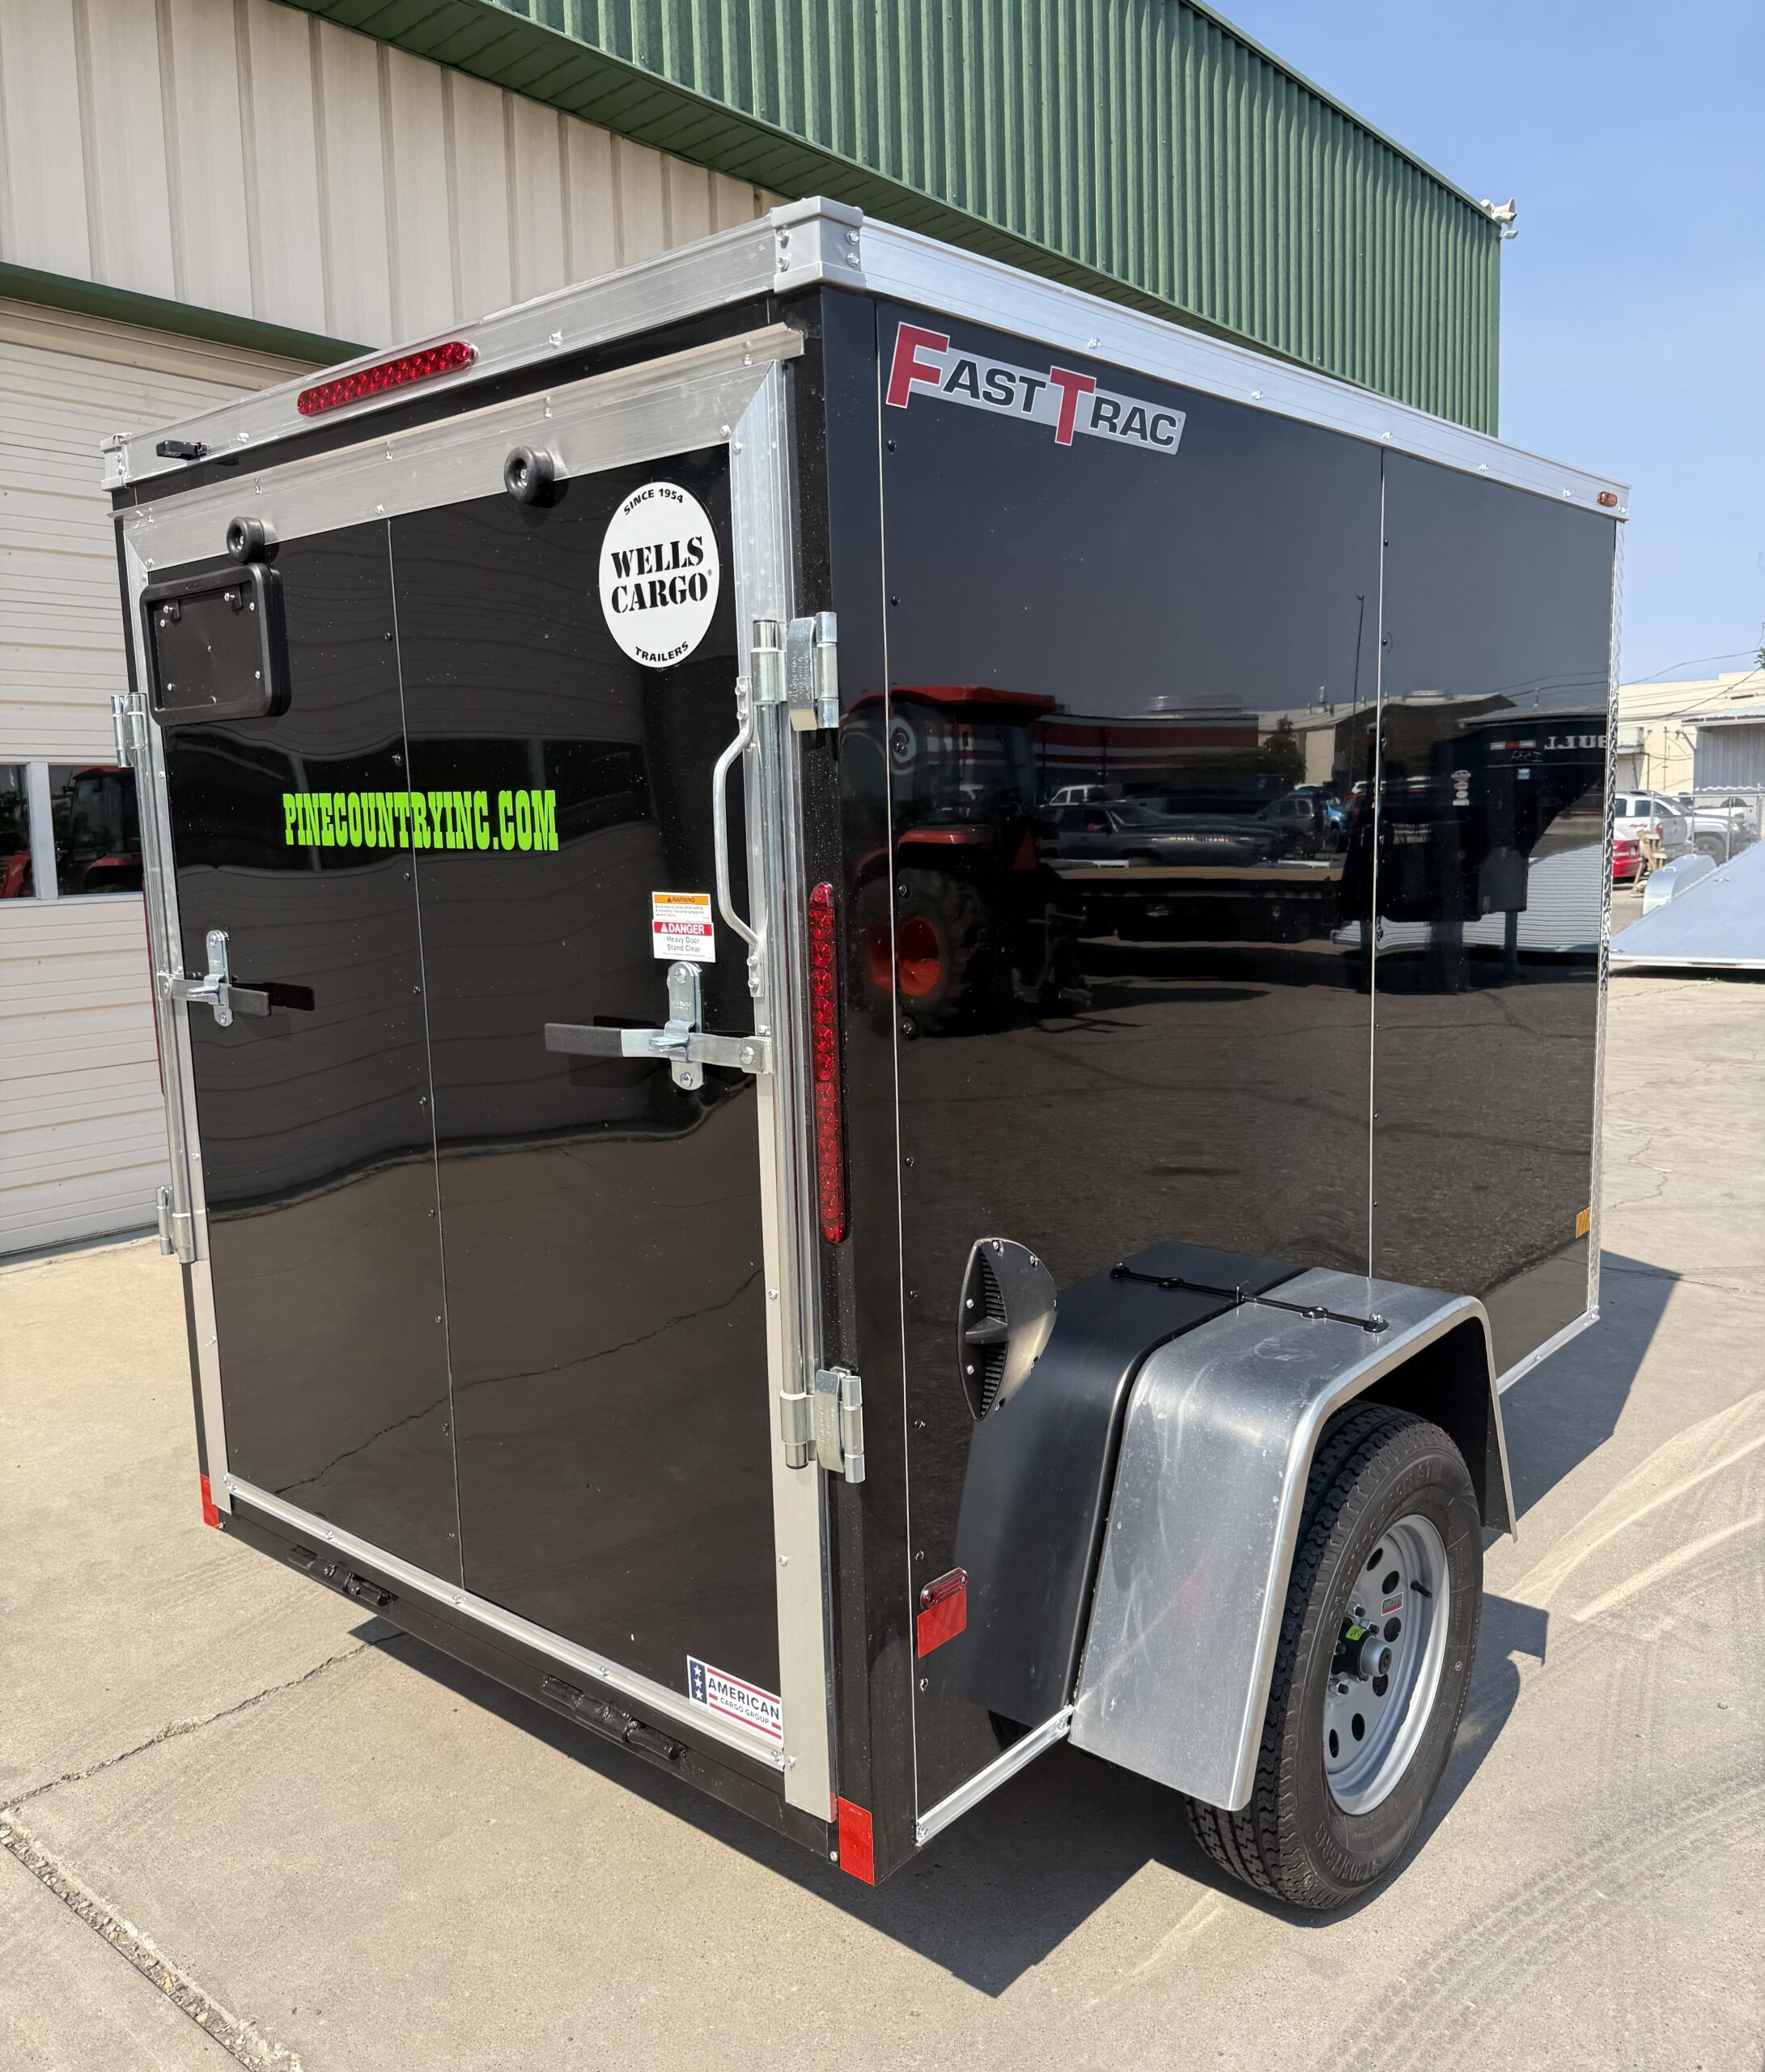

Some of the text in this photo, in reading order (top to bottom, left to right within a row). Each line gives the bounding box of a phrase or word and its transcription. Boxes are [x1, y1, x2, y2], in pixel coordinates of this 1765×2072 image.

[623, 489, 684, 515] SINCE 1954
[611, 536, 704, 579] WELLS
[611, 572, 708, 614] CARGO
[635, 641, 689, 662] TRAILERS
[282, 789, 559, 851] PINECOUNTRYINC.COM
[666, 936, 700, 945] Heavy Door
[668, 923, 705, 935] DANGER
[667, 944, 701, 953] Stand Clear
[708, 1678, 779, 1720] AMERICAN
[720, 1697, 770, 1725] CARGO GROUP
